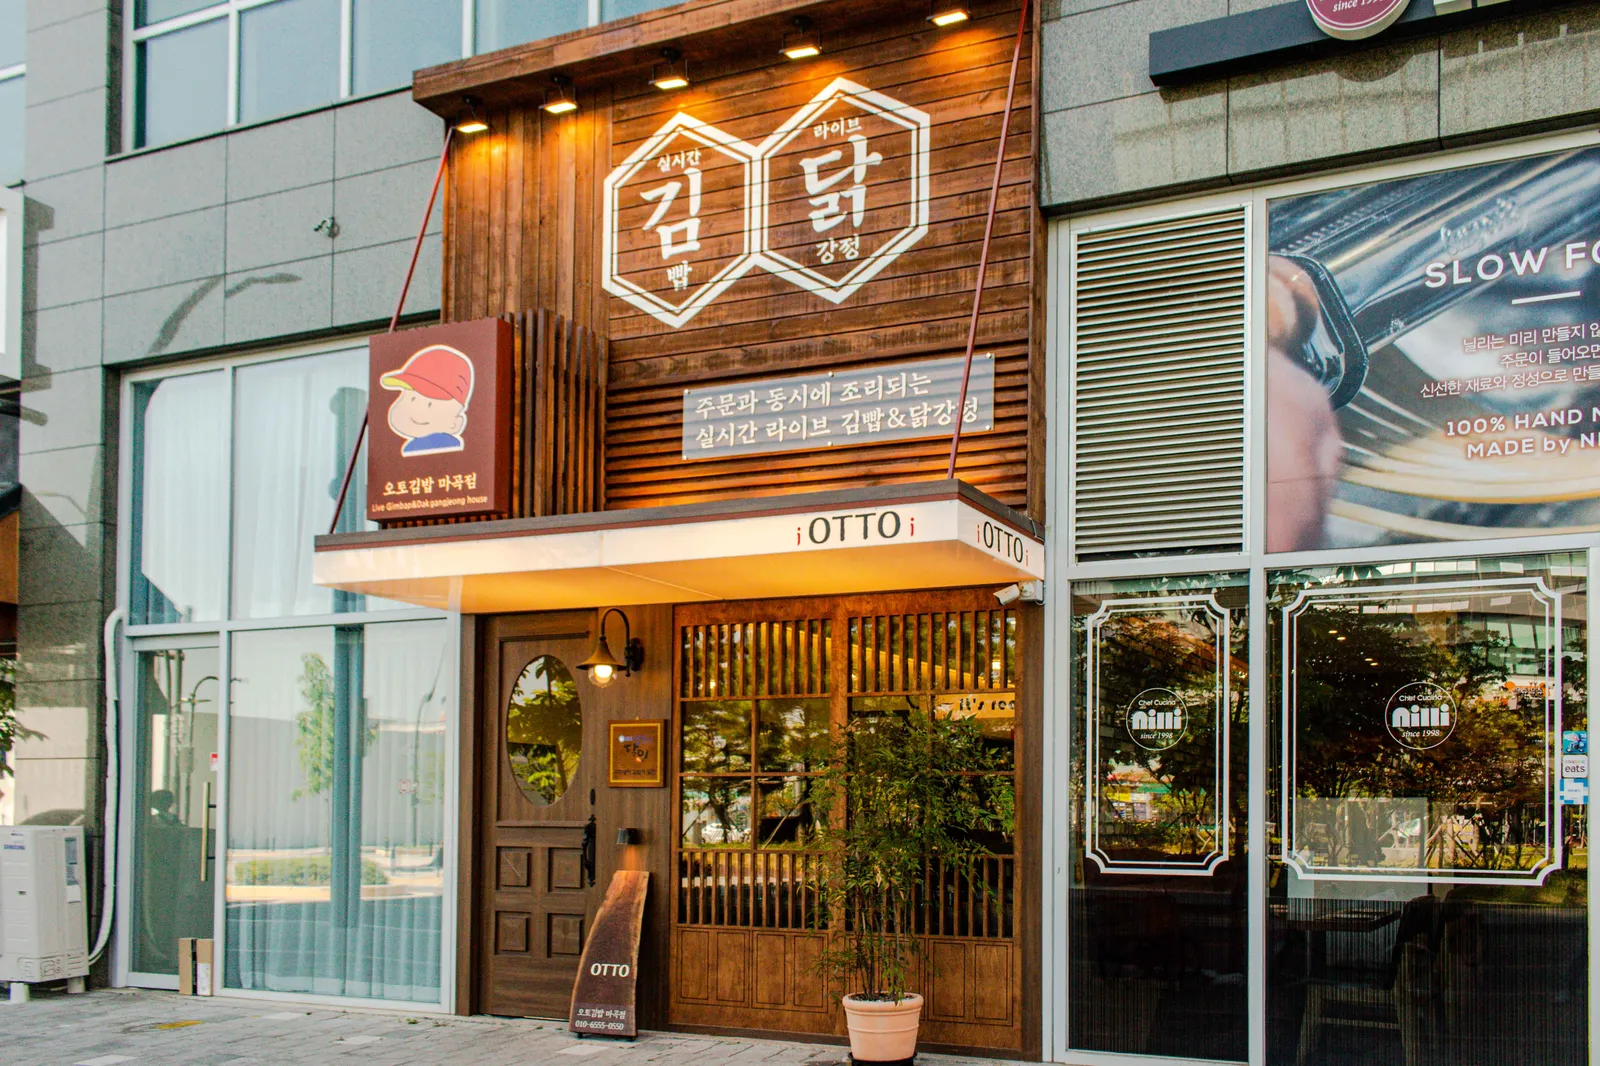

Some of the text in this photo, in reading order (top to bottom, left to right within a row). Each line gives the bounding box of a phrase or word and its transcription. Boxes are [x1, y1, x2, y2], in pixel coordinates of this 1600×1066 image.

[1333, 0, 1358, 12] since
[813, 117, 862, 140] 라이브
[657, 149, 702, 172] 실시간
[799, 134, 883, 233] 닭
[640, 168, 702, 260] 김
[816, 234, 860, 264] 강정
[1424, 246, 1548, 288] SLOW
[1463, 335, 1505, 352] 닐리는
[1509, 329, 1537, 347] 미리
[1542, 323, 1585, 344] 만들지
[1500, 349, 1542, 368] 주문이
[695, 372, 932, 420] 주문과 동시에 조리되는
[1420, 380, 1461, 399] 신선한
[1465, 376, 1508, 392] 재료와
[1512, 369, 1568, 388] 정성으로
[695, 420, 758, 449] 실시간
[766, 415, 832, 442] 라이브
[1447, 416, 1506, 436] 100%
[1515, 408, 1583, 429] HAND
[1467, 438, 1534, 459] MADE
[1544, 437, 1571, 454] by
[383, 472, 477, 496] 오토김밥 마곡점
[371, 503, 385, 512] Live
[466, 495, 488, 505] house
[808, 510, 901, 544] OTTO
[983, 521, 1023, 563] OTTO
[1422, 729, 1440, 737] 1998
[1565, 764, 1585, 773] eats
[590, 963, 630, 978] OTTO
[577, 1008, 604, 1018] 오토김밥
